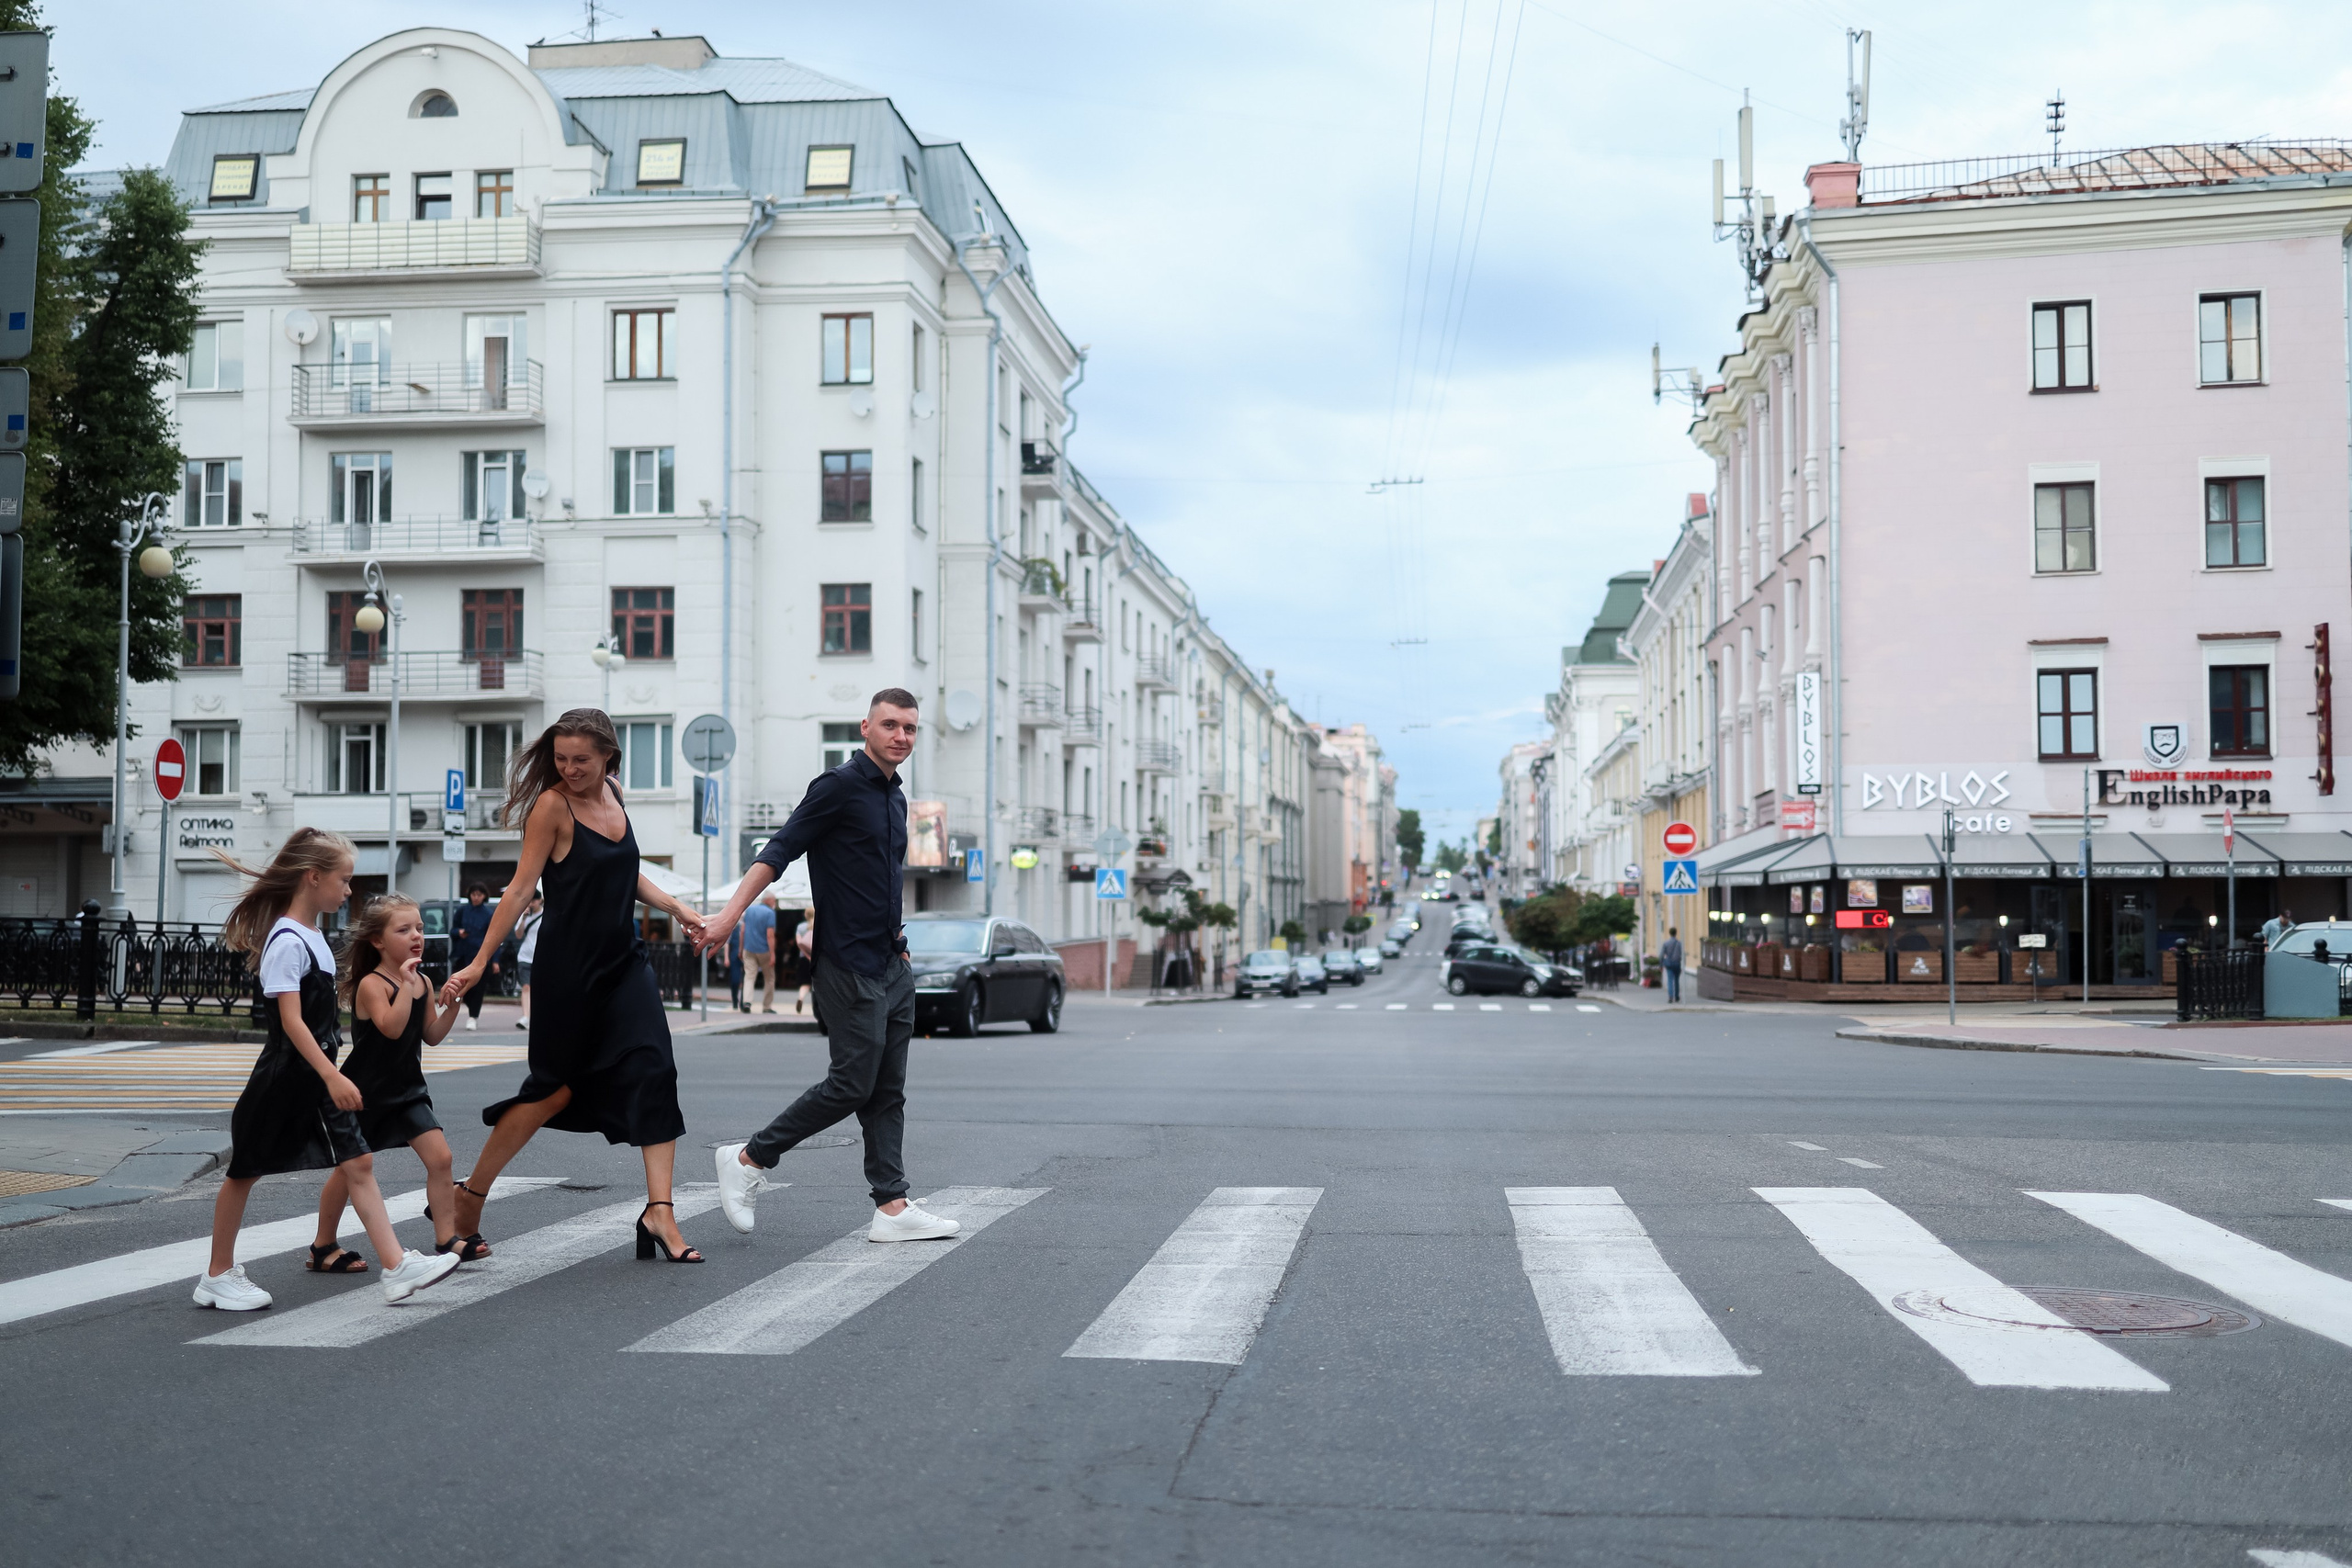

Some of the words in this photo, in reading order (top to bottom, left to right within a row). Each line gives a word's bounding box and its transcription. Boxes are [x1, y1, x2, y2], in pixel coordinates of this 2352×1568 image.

[1803, 675, 1815, 782] BYBLOS
[450, 773, 461, 807] P
[1862, 770, 2010, 810] BYBLOS
[2130, 769, 2177, 782] Школа
[2184, 768, 2272, 781] английского
[1949, 812, 2011, 833] cafe
